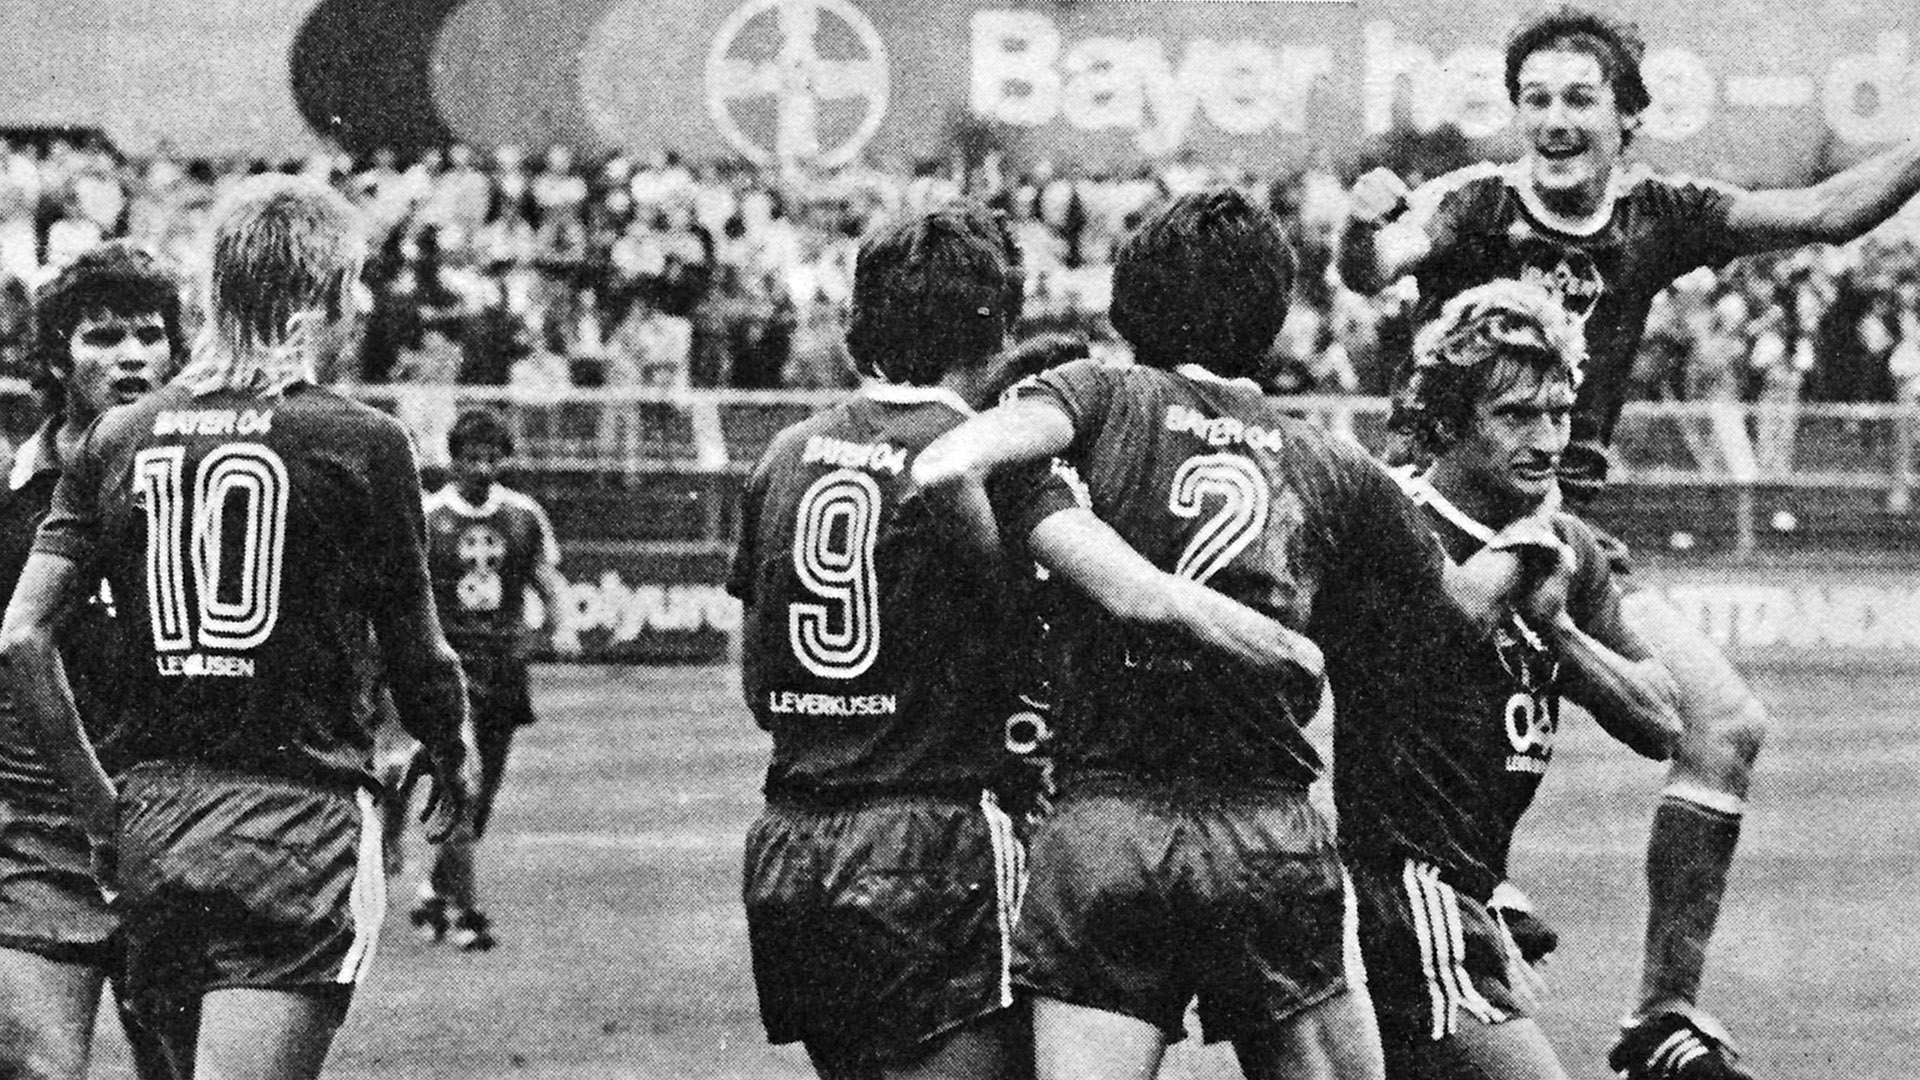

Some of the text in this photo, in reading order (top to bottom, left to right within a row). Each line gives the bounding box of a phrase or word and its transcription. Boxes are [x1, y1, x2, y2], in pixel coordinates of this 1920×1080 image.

[969, 9, 1333, 155] Bayer
[132, 441, 289, 651] 10
[789, 468, 881, 680] 9
[1168, 451, 1269, 585] 2
[769, 690, 897, 717] LEVERKUSEN
